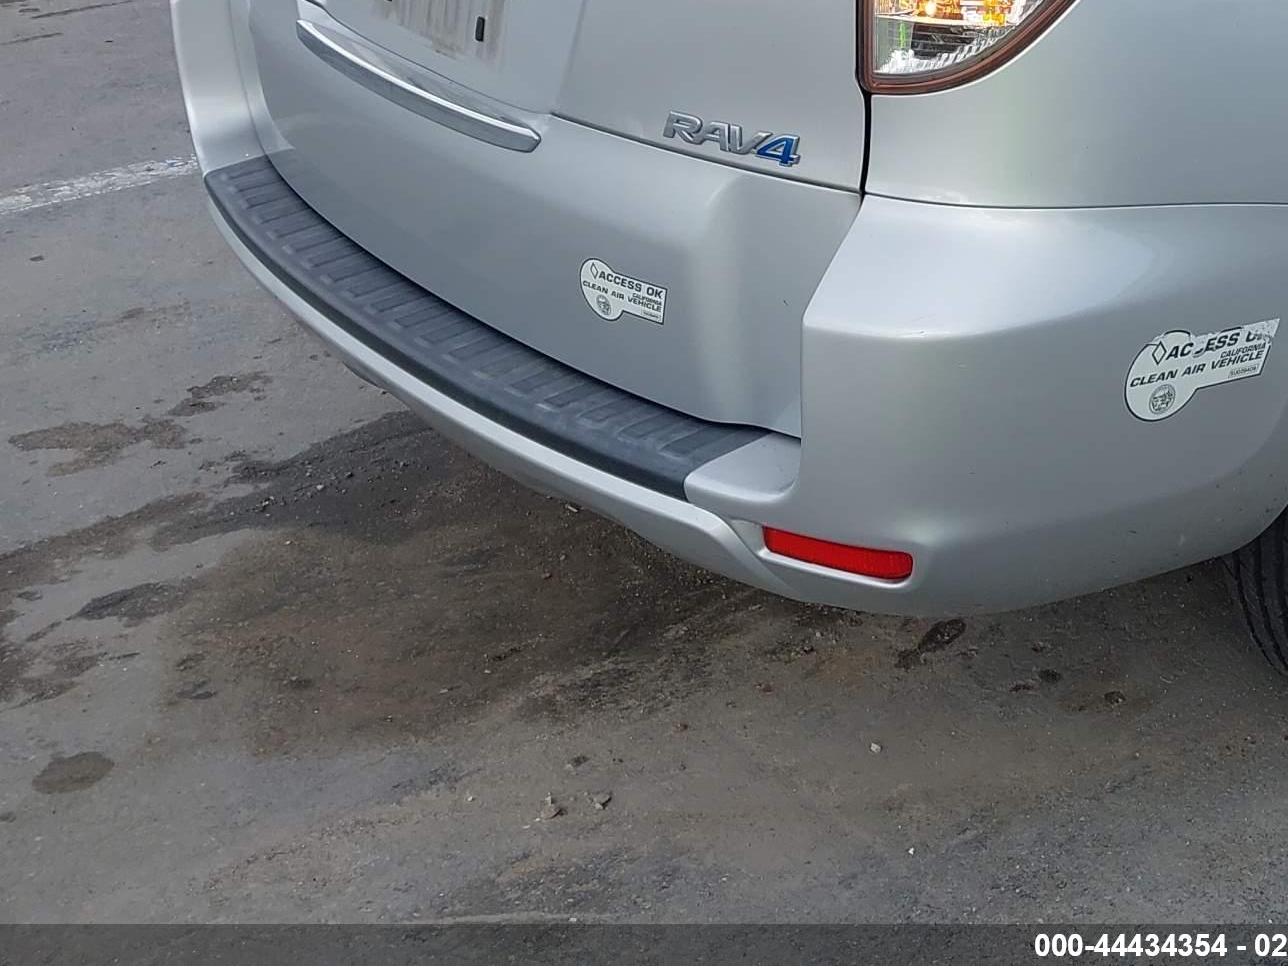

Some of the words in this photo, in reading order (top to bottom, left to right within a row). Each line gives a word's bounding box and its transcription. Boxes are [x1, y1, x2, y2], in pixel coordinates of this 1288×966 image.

[663, 110, 801, 167] RAV4
[582, 280, 608, 294] CLEAN
[611, 290, 625, 301] AIR
[627, 296, 661, 312] VEHICLE
[599, 270, 642, 292] ACCESS
[646, 286, 664, 299] OK
[1220, 341, 1266, 358] CALIFORNIA
[1130, 369, 1177, 388] CLEAN
[1182, 363, 1206, 378] AIR
[1211, 350, 1264, 370] VEHICLE
